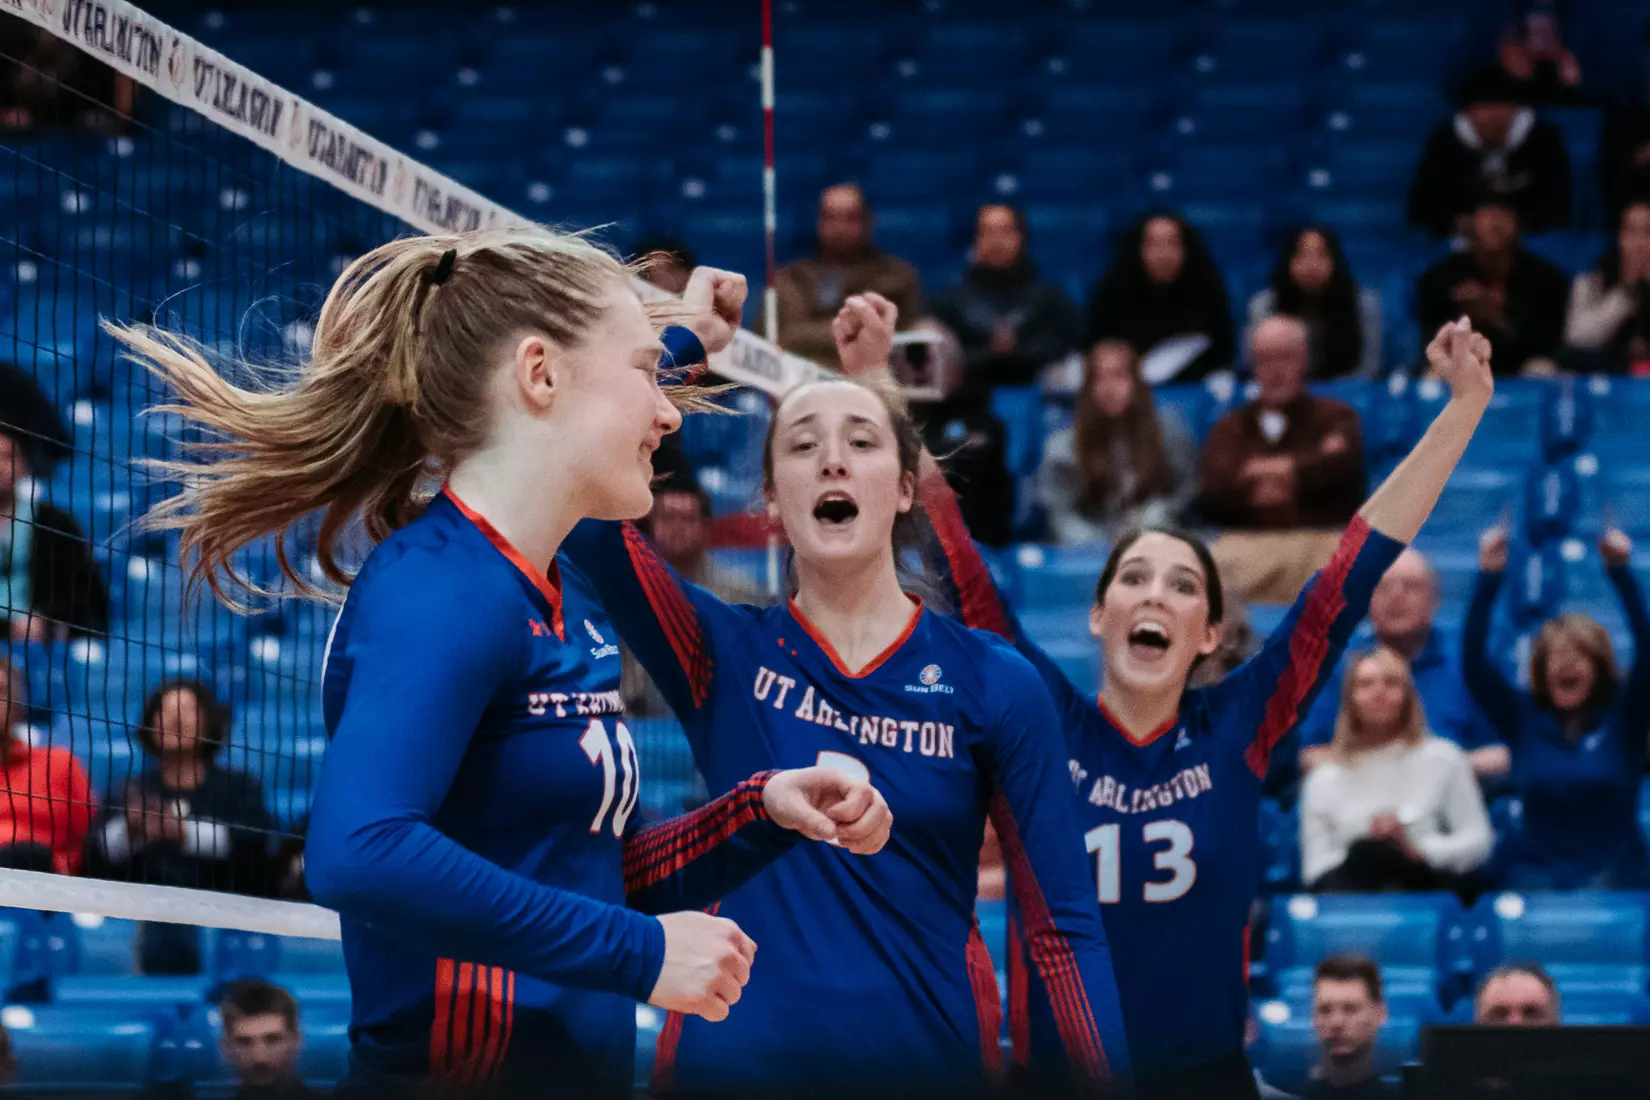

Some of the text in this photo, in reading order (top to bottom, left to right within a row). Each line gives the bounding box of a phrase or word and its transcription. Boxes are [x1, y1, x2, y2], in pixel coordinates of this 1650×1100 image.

[84, 0, 163, 80] ARLINTON
[754, 665, 955, 759] UT ARLINGTON
[904, 684, 929, 694] SUN
[578, 717, 640, 839] 10
[1088, 761, 1213, 814] ARLINGTON
[1083, 818, 1198, 905] 13
